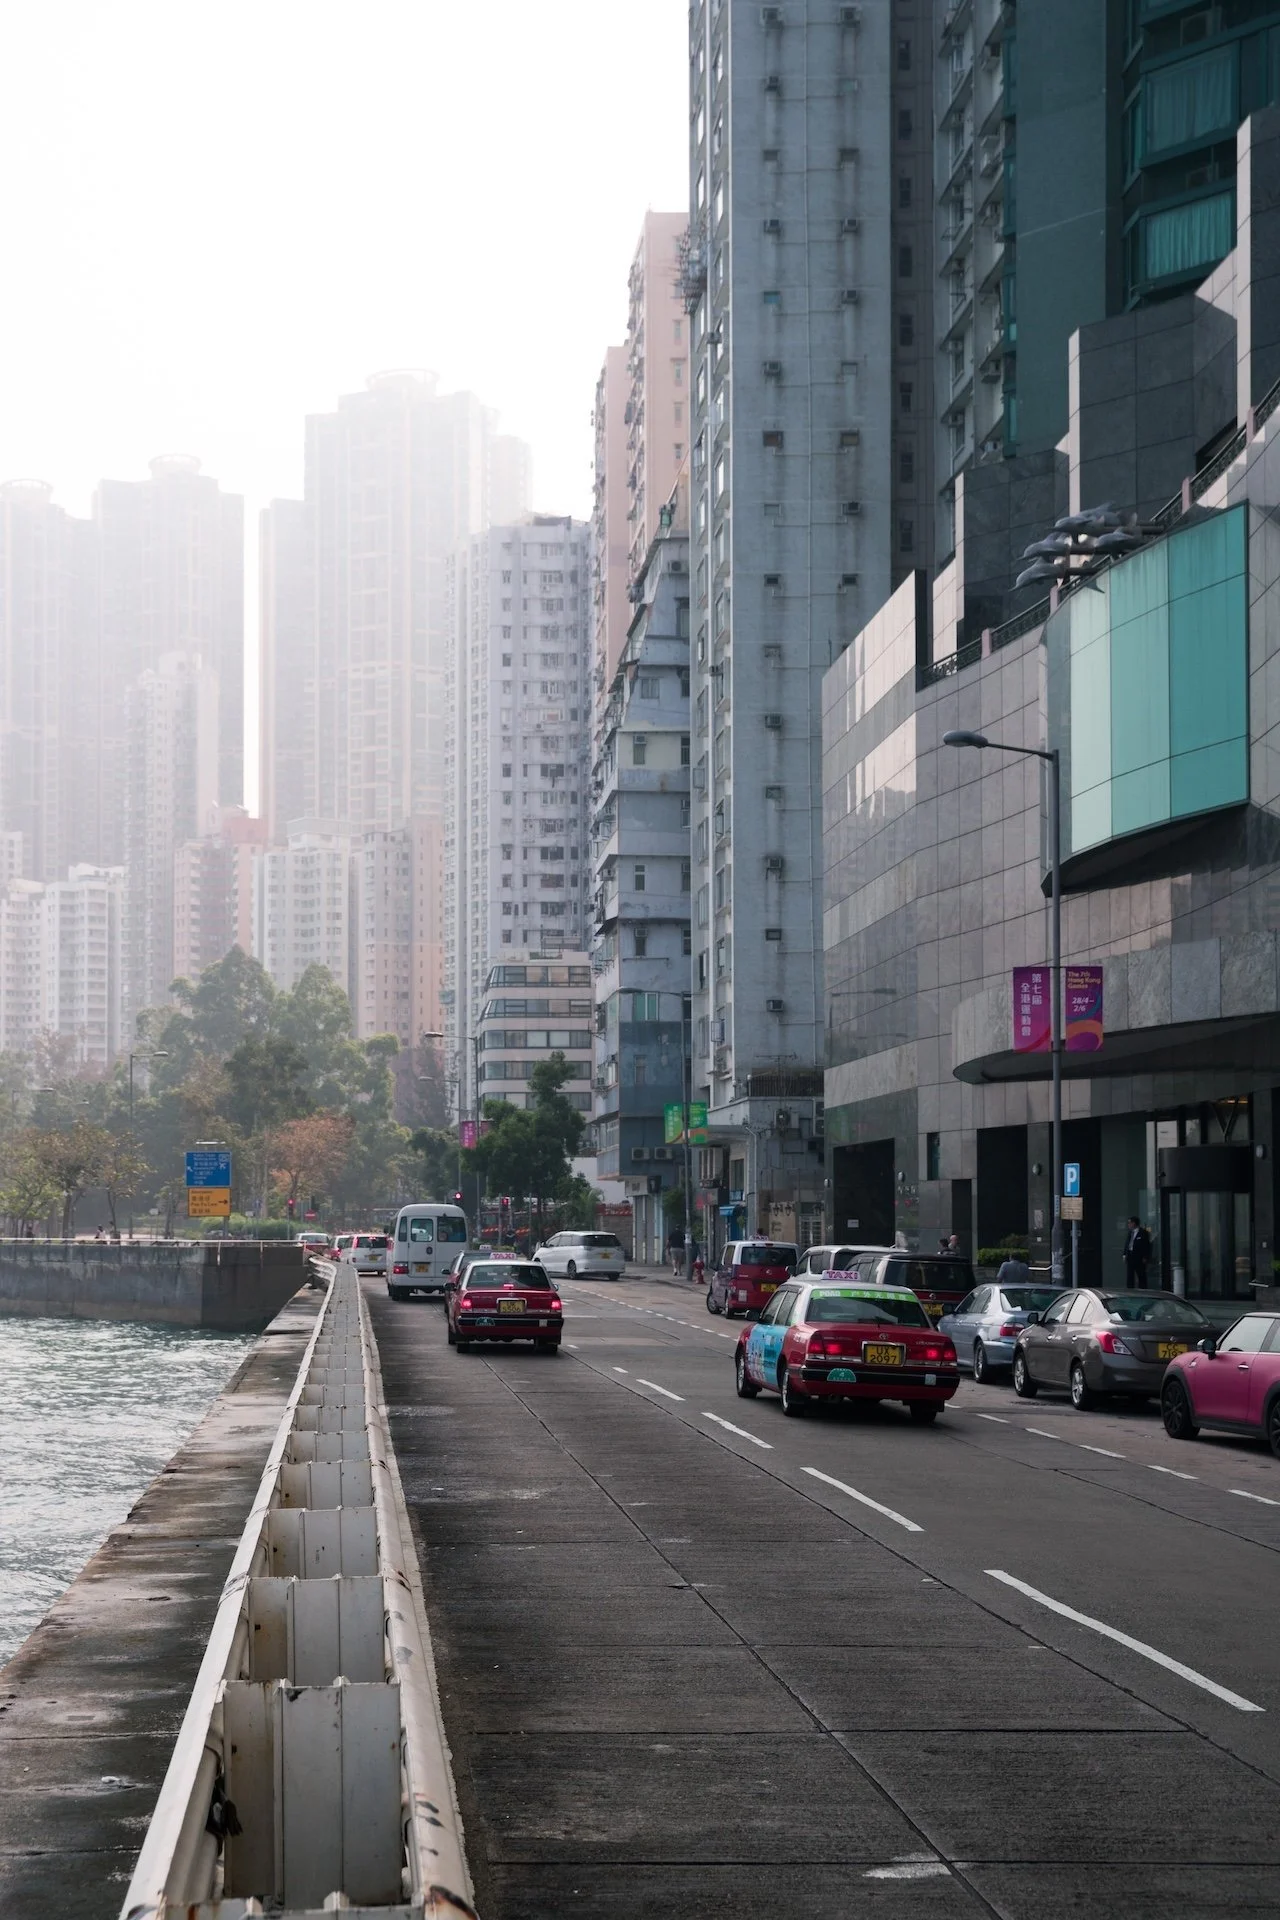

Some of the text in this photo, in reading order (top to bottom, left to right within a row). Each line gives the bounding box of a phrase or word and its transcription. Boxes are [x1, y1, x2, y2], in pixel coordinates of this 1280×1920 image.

[1066, 1167, 1076, 1192] P
[826, 1271, 858, 1280] TAXI
[876, 1346, 890, 1354] UX
[1162, 1350, 1183, 1358] 719
[870, 1354, 897, 1364] 2097
